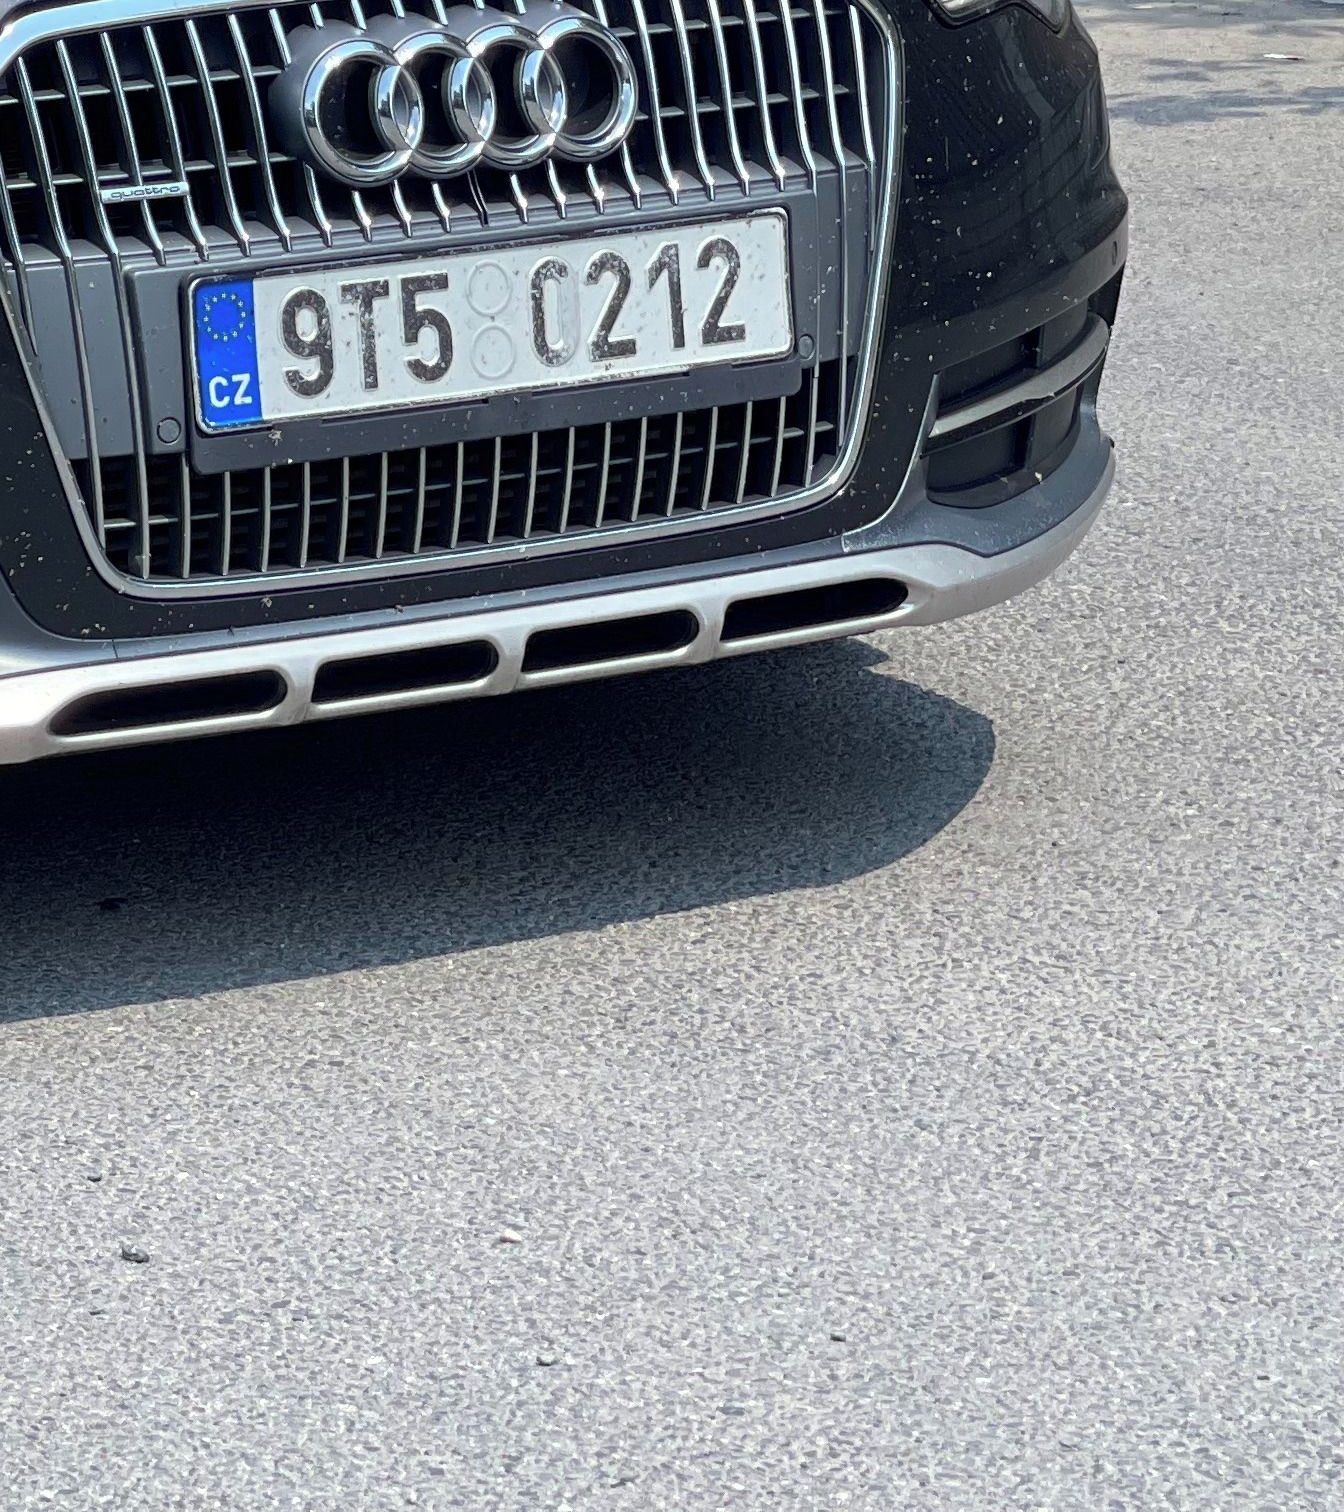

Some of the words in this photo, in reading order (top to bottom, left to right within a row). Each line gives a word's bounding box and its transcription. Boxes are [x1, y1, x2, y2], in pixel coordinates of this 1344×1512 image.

[110, 185, 181, 200] quattro
[280, 271, 454, 399] 9T5
[528, 234, 747, 369] 0212
[208, 372, 254, 409] CZ
